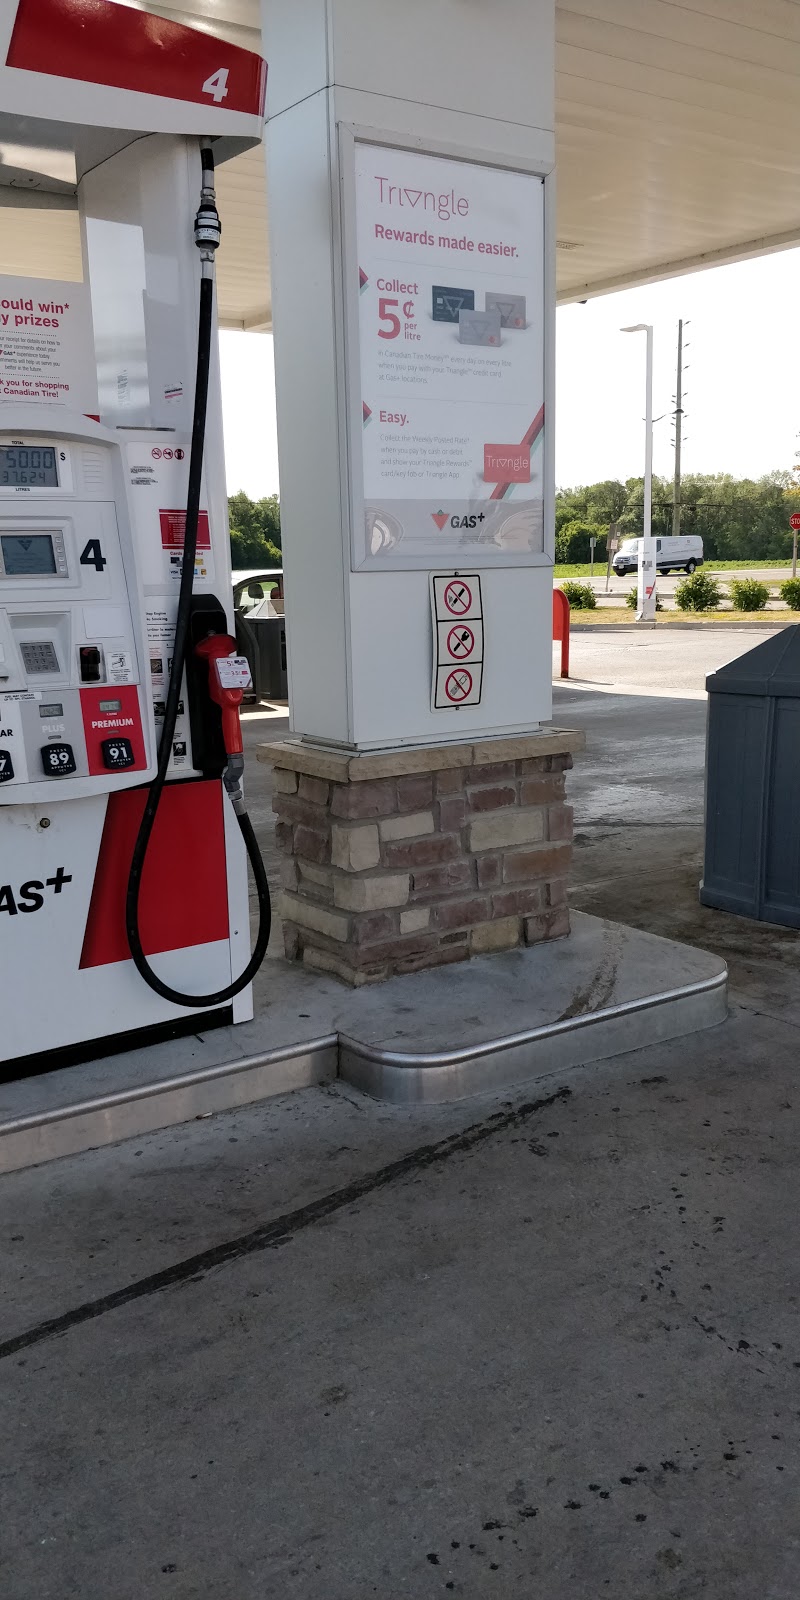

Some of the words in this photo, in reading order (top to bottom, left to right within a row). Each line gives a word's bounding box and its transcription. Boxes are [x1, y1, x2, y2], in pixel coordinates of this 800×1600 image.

[202, 67, 230, 103] 4
[374, 223, 435, 246] Rewards
[438, 236, 475, 252] made
[477, 242, 519, 258] easier.
[376, 278, 419, 295] Collect
[0, 299, 33, 311] ould
[15, 314, 59, 328] prizes
[404, 322, 418, 331] per
[404, 331, 422, 341] litre
[385, 350, 411, 359] Canadian
[413, 352, 424, 360] Tire
[35, 381, 69, 391] shopping
[4, 387, 40, 396] Canadian
[41, 390, 59, 398] Tire!
[379, 410, 409, 427] Easy.
[380, 434, 400, 442] Collect
[60, 452, 66, 461] $
[449, 471, 460, 479] App
[450, 512, 486, 529] GAS+
[80, 539, 106, 571] 4
[42, 724, 65, 733] PLUS
[92, 718, 134, 729] PREMIUM
[109, 746, 128, 760] 91
[49, 752, 70, 766] 89
